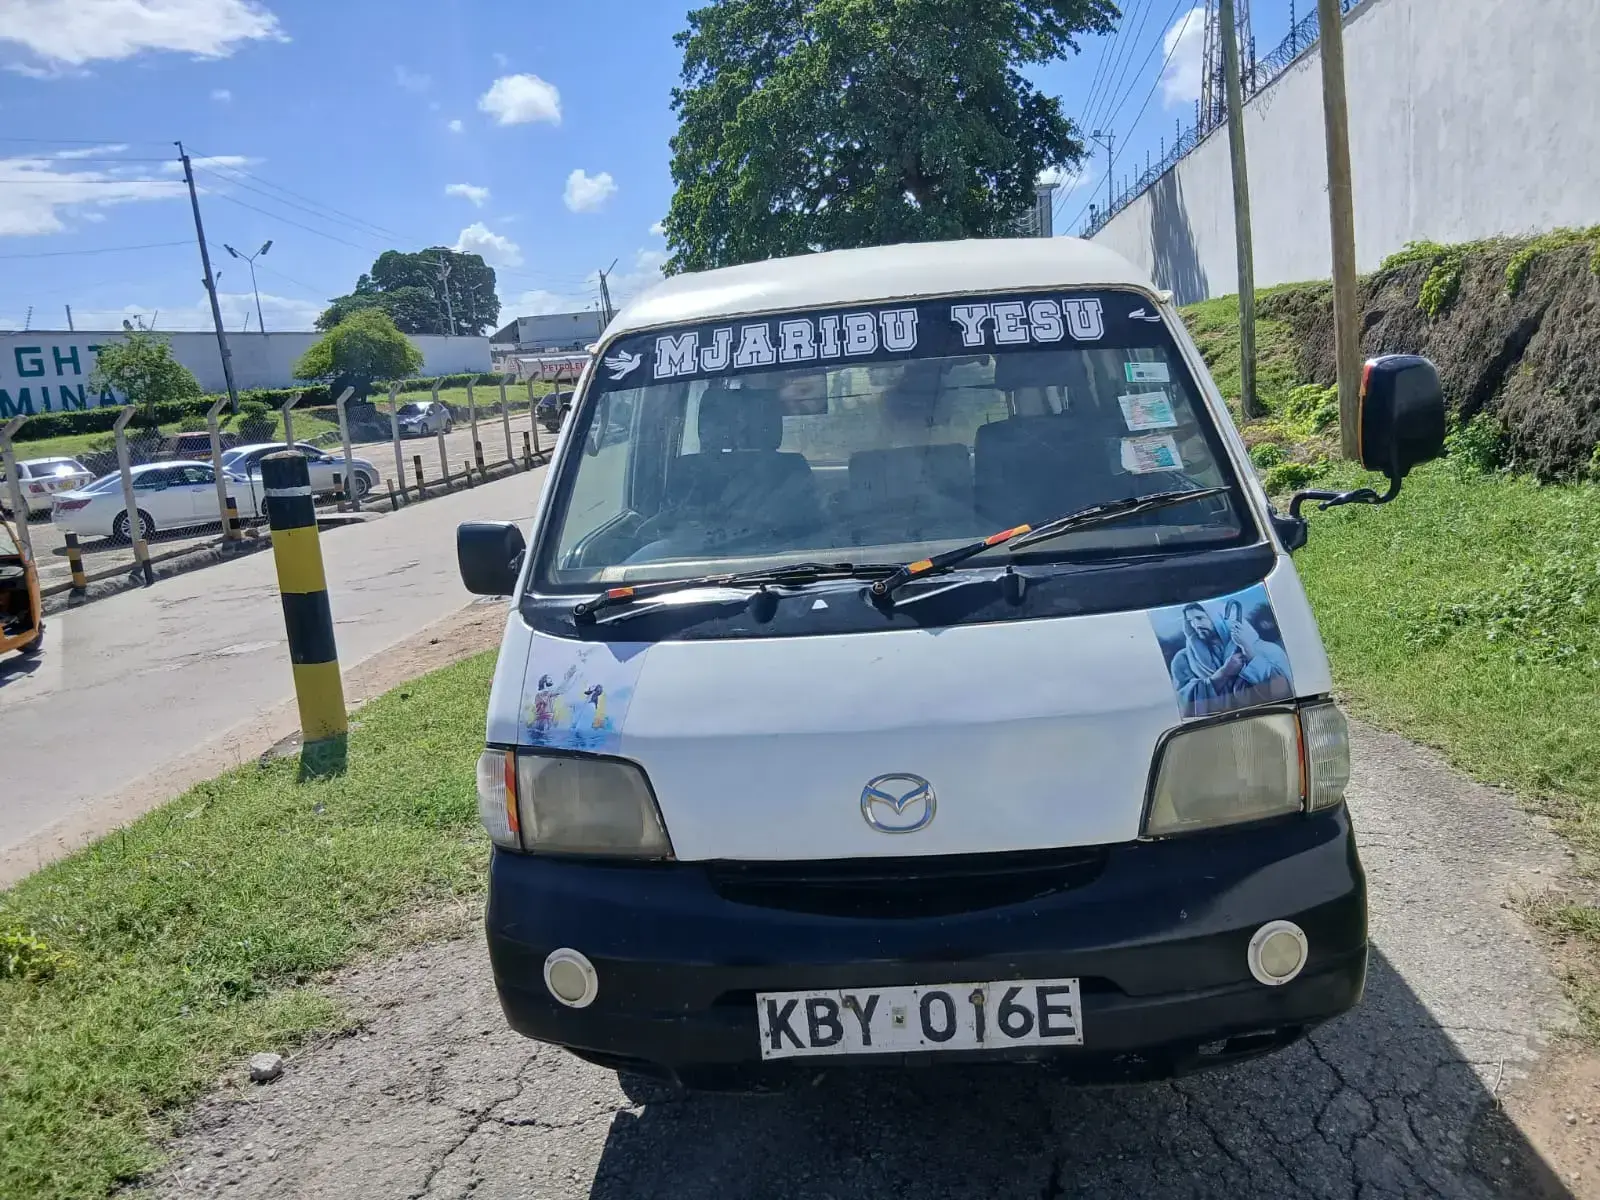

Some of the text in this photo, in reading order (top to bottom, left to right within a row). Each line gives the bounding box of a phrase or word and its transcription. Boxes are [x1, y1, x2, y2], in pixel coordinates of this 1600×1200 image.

[654, 298, 1103, 379] MJARIBU YESU
[0, 384, 130, 418] MINA
[766, 986, 1076, 1049] KBY 016E
